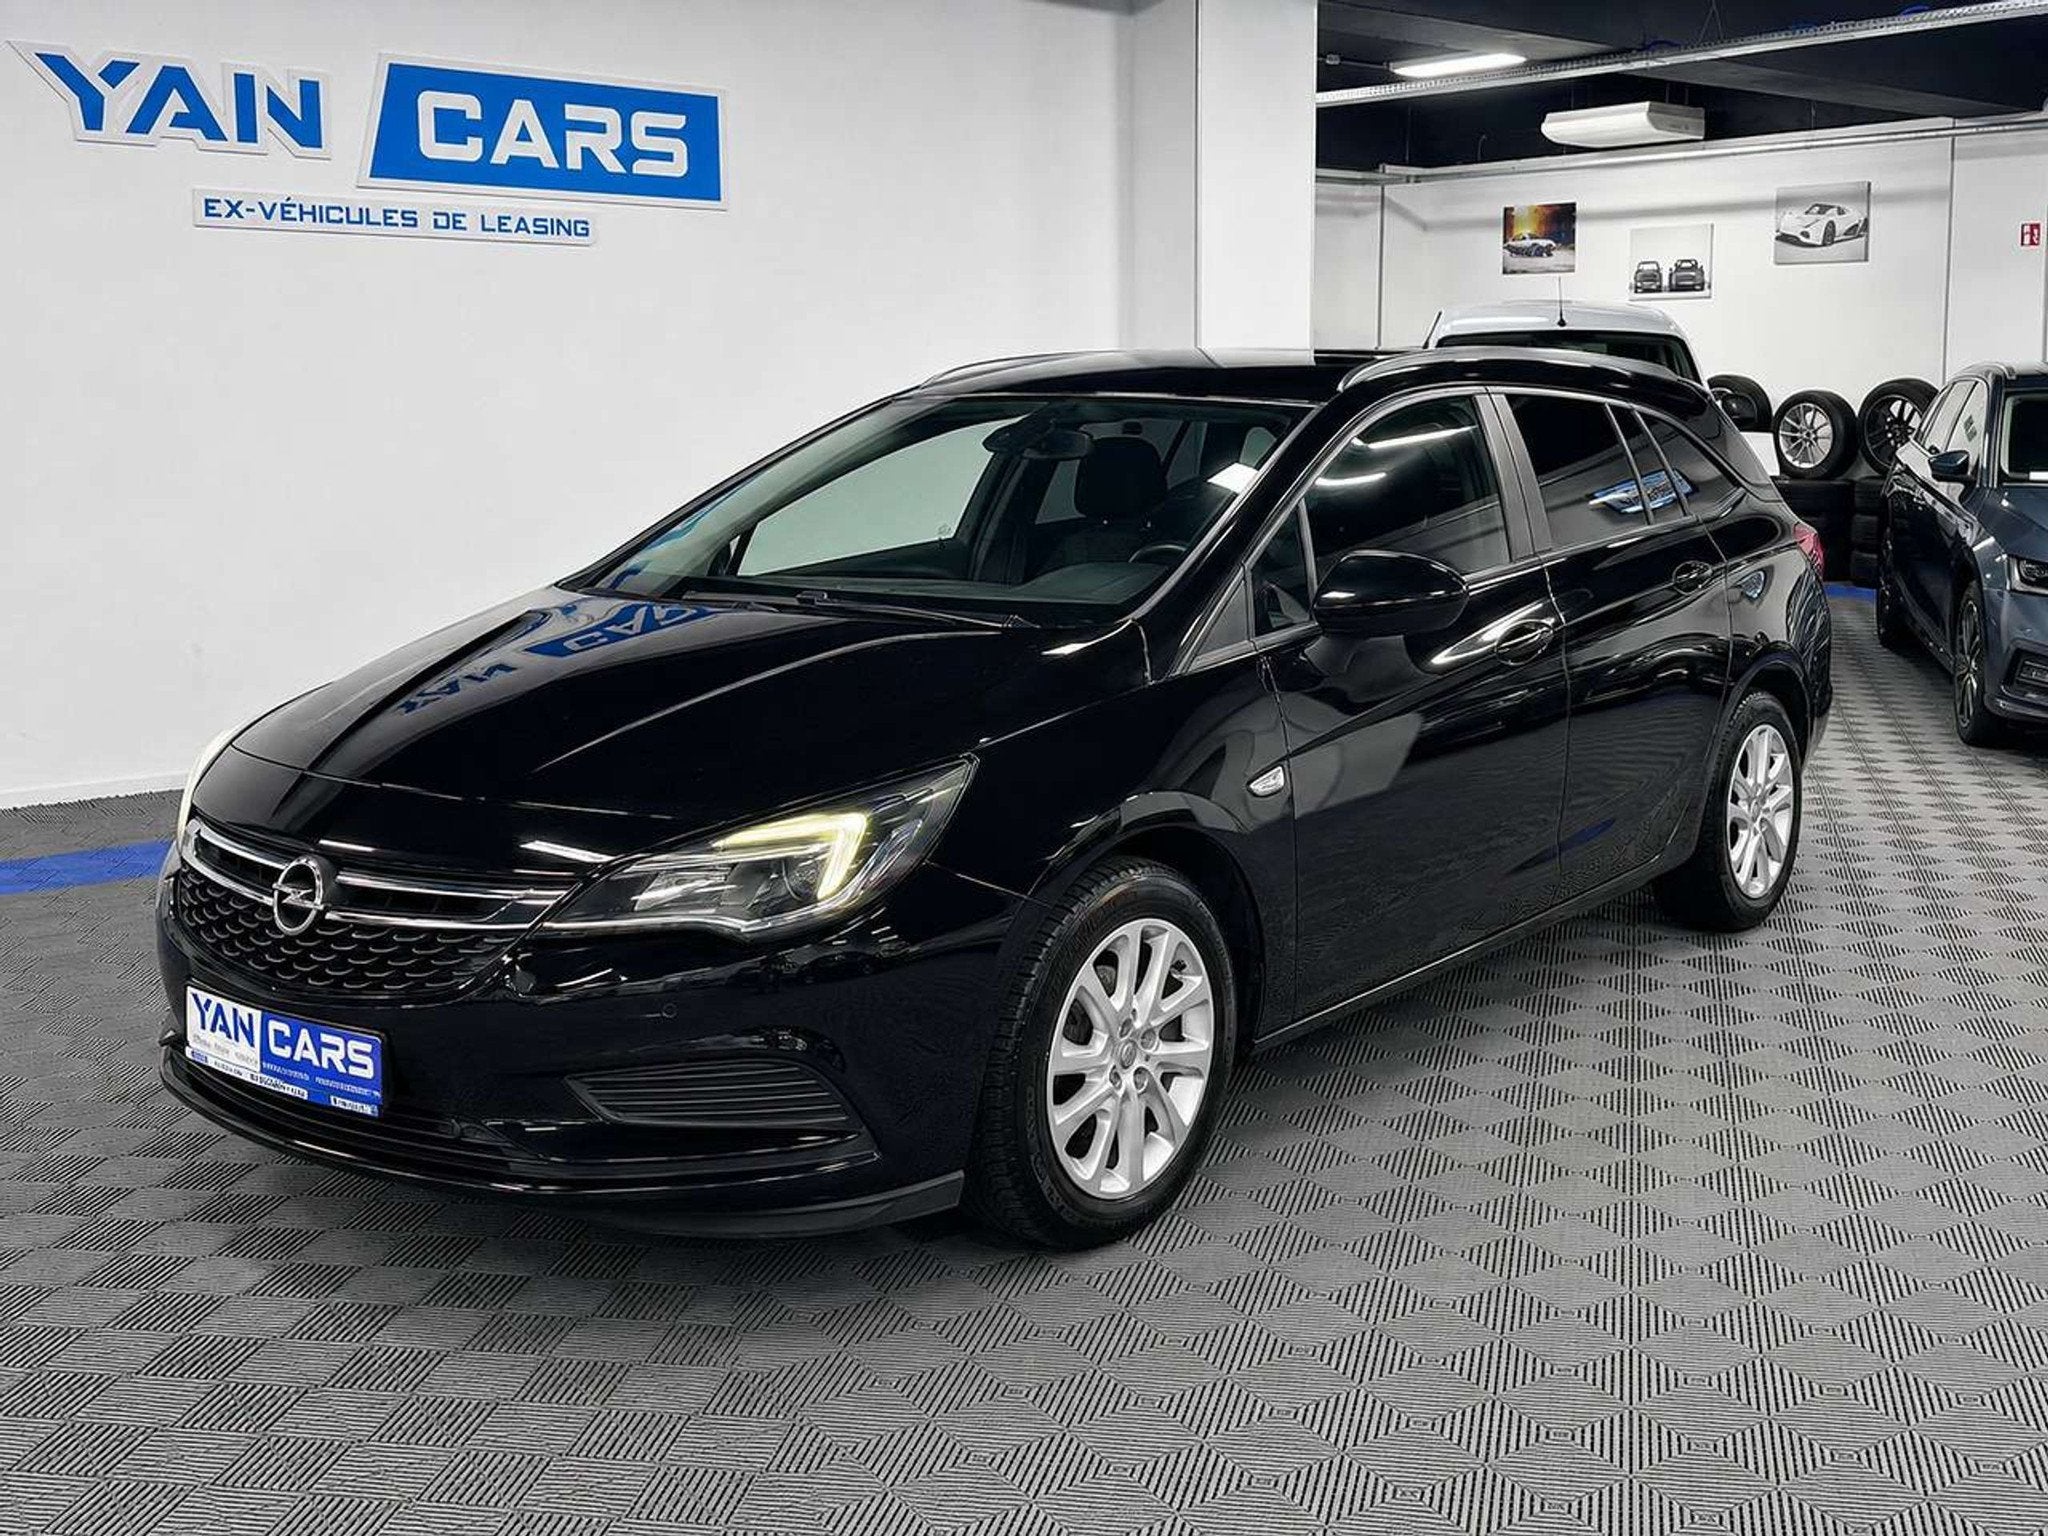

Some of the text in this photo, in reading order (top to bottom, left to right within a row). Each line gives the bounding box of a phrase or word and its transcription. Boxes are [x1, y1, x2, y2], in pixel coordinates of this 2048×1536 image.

[35, 53, 689, 179] YAN CARS
[203, 192, 591, 238] EX-VÉHICULES DE LEASING
[192, 993, 255, 1048] YAN
[267, 1018, 374, 1080] CARS
